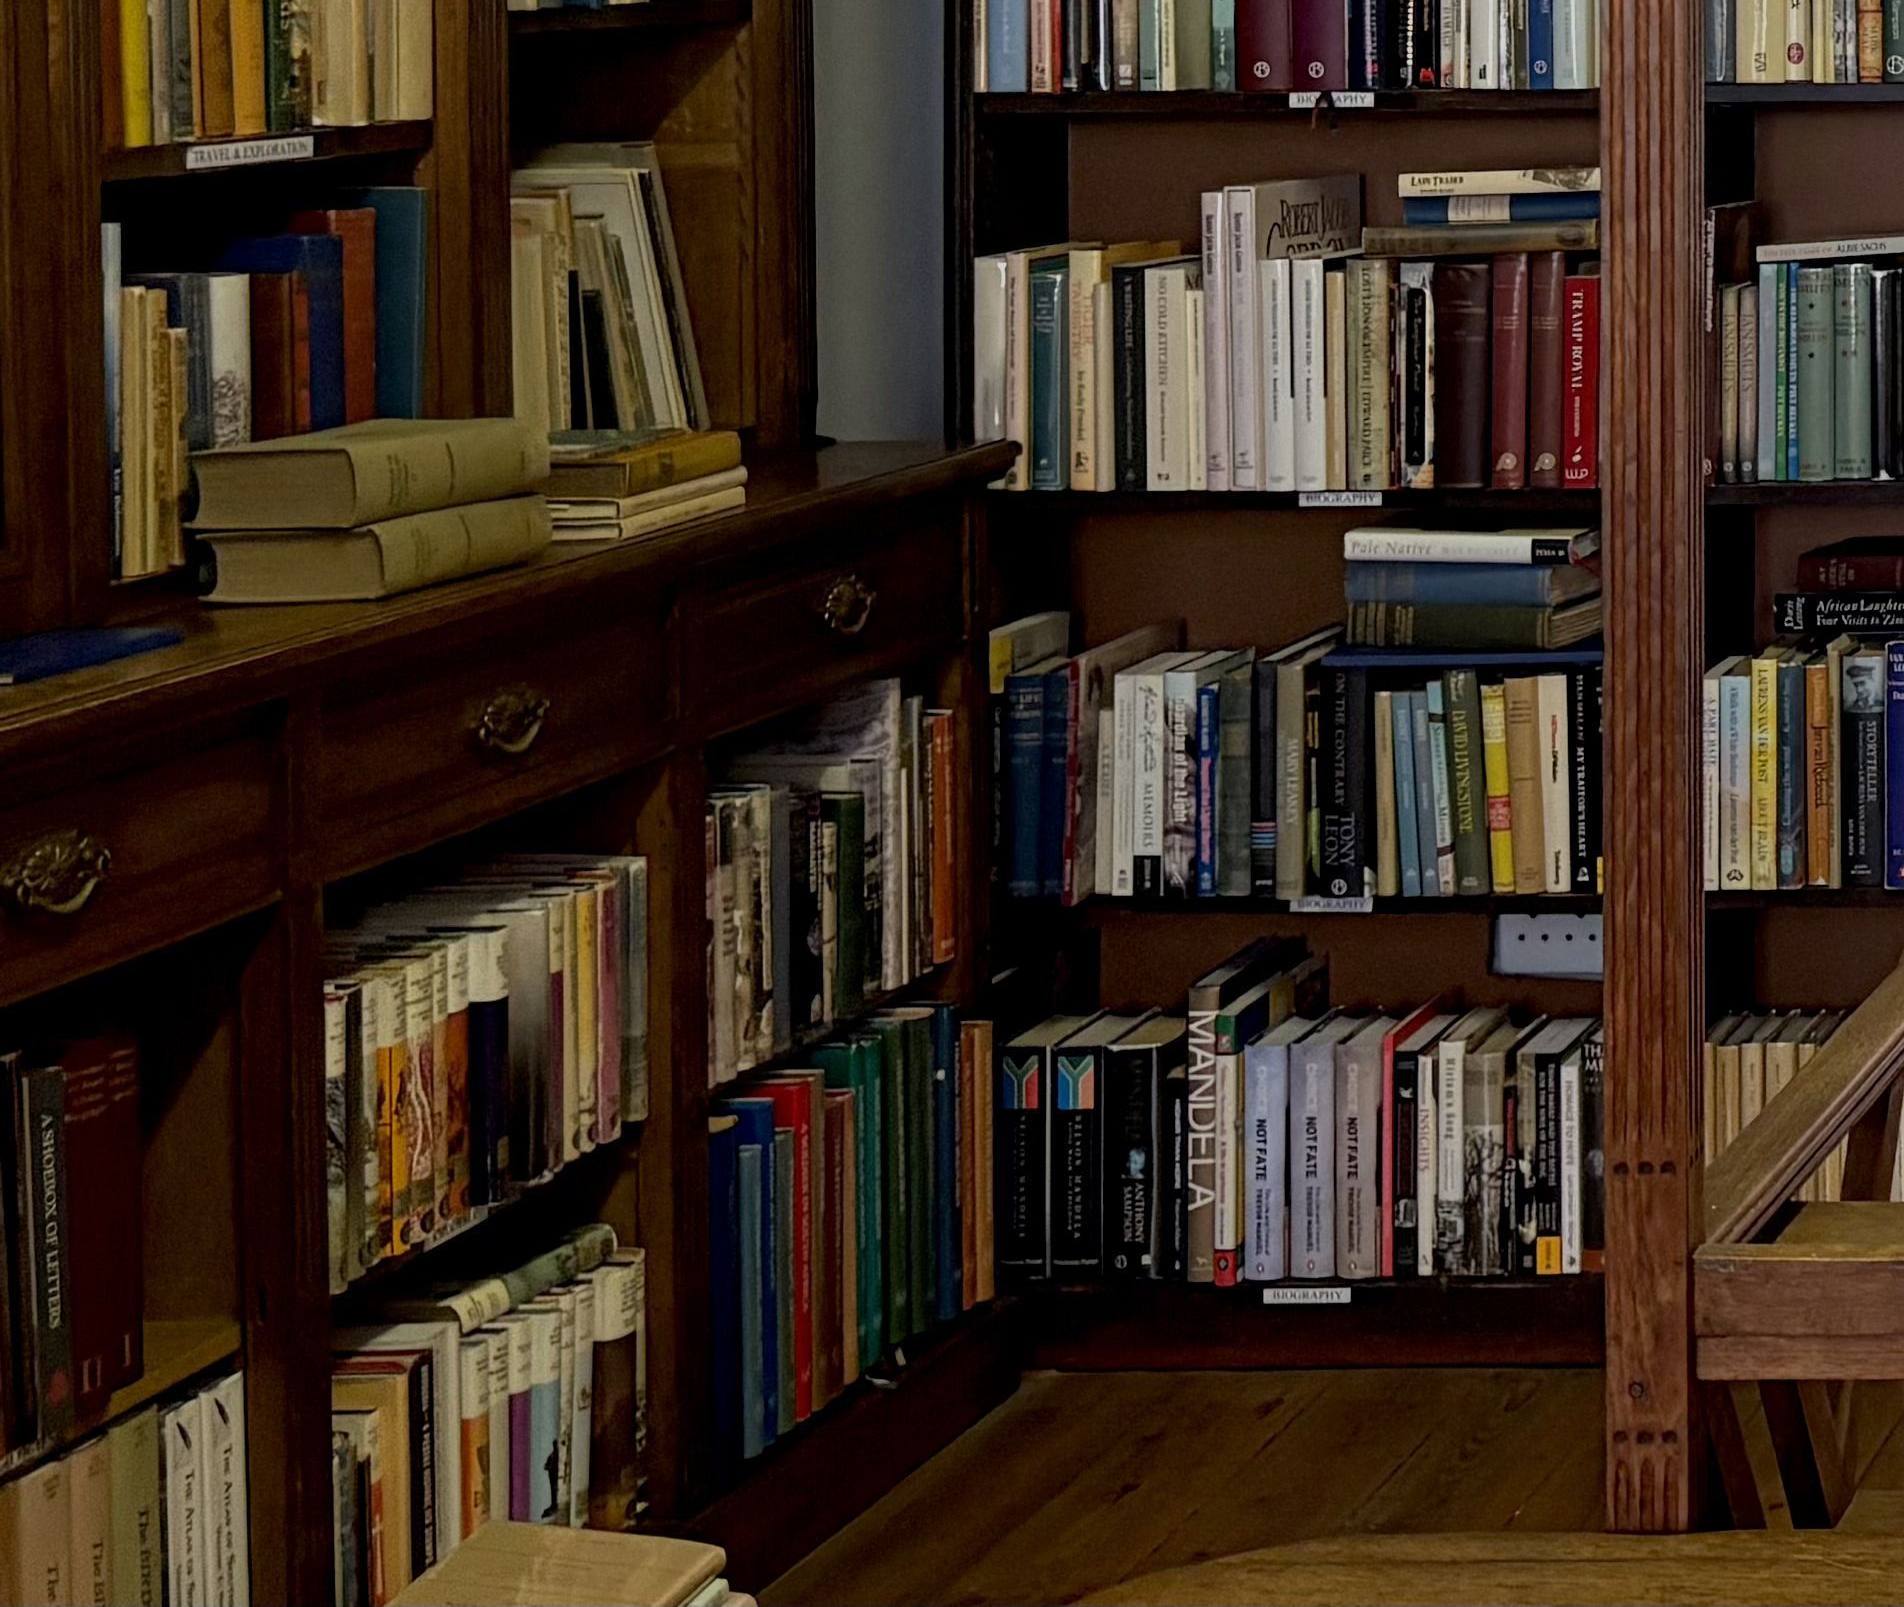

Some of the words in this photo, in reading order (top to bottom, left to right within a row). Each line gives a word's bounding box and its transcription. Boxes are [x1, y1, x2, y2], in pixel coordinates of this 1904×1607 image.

[192, 146, 229, 164] TRAVEL
[1570, 291, 1584, 343] TRAMP
[1306, 492, 1376, 503] BIOGRAPHY
[1351, 541, 1381, 555] Pale
[1385, 542, 1433, 556] Native
[1816, 600, 1858, 613] African
[1334, 674, 1345, 693] ON
[1755, 669, 1768, 716] LAURENS
[1334, 699, 1345, 722] THE
[1173, 753, 1187, 766] of
[1335, 729, 1345, 805] CONTRARY
[1755, 758, 1768, 784] POST
[1865, 721, 1876, 802] STORYTELLER
[1173, 768, 1187, 788] the
[1142, 783, 1154, 849] MEMOIRS
[1170, 790, 1187, 822] Light
[1323, 815, 1337, 865] LEON
[1338, 811, 1354, 867] TONY
[1297, 898, 1367, 909] BIOGRAPHY
[1187, 1010, 1214, 1211] MANDELA
[1254, 1118, 1267, 1146] NOT
[1304, 1116, 1317, 1144] NOT
[1345, 1116, 1358, 1144] NOT
[1418, 1108, 1429, 1172] INSIGHTS
[1254, 1148, 1267, 1182] FATE
[1304, 1145, 1317, 1179] FATE
[1345, 1146, 1358, 1180] FATE
[1122, 1186, 1132, 1243] SAMPSON
[1133, 1183, 1144, 1244] ANTHONY
[44, 1222, 58, 1245] OF
[45, 1251, 61, 1329] LETTERS
[1273, 1289, 1343, 1301] BIOGRAPHY
